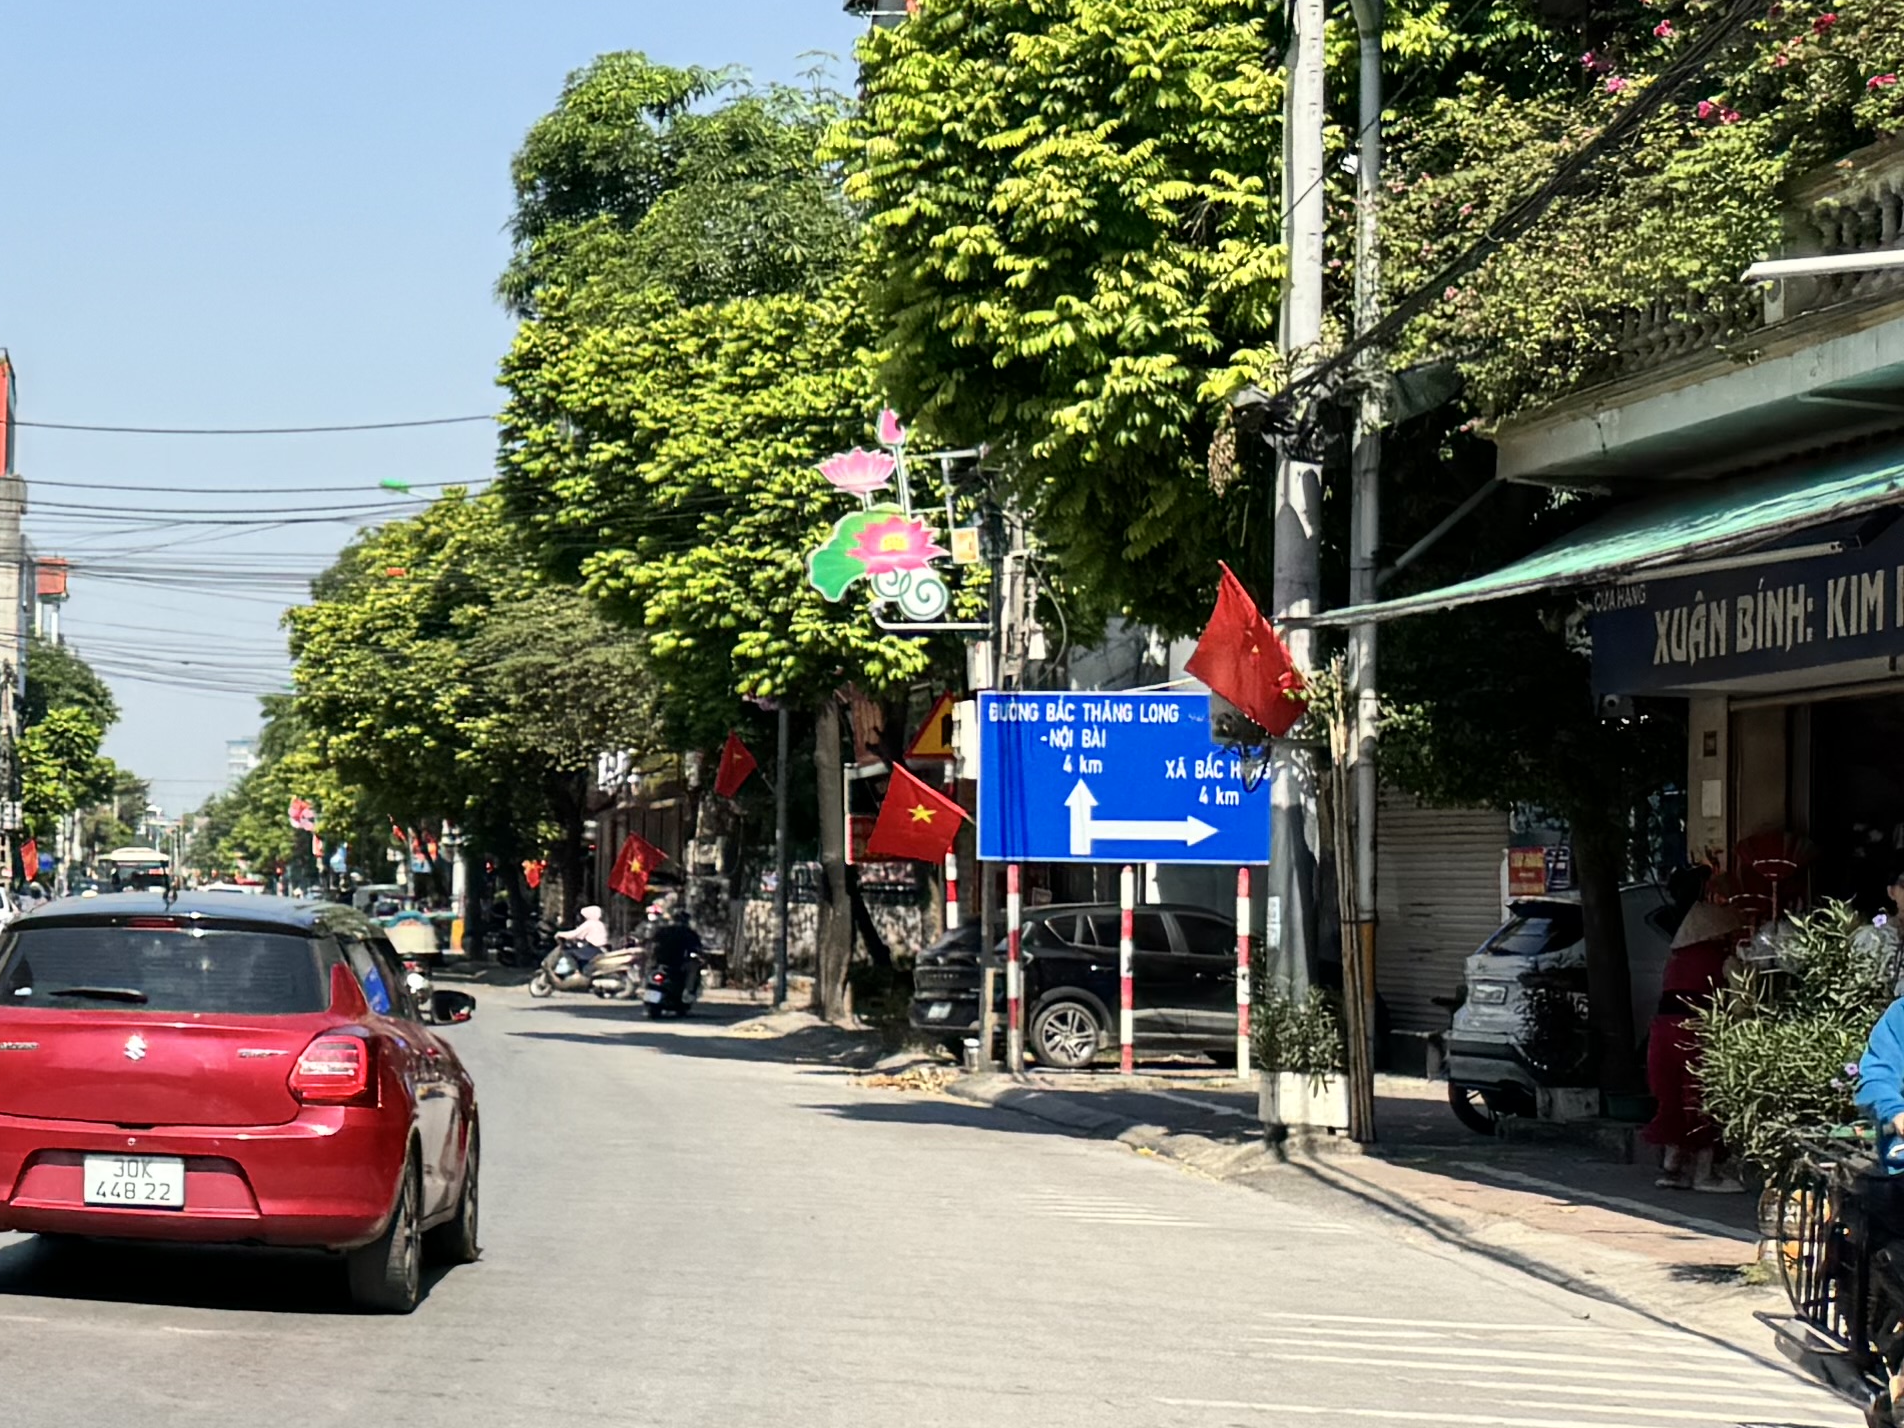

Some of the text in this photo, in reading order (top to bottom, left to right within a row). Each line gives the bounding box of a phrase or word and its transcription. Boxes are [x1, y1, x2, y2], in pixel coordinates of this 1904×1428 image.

[1653, 590, 1727, 667] XUÂN
[1827, 569, 1885, 640] KIM
[1045, 695, 1075, 722] BẮC
[1082, 700, 1133, 722] THĂNG
[1139, 704, 1180, 724] LONG
[1082, 725, 1106, 749] BÀI
[1063, 754, 1103, 774] 4 km
[1165, 755, 1187, 779] XÃ
[1195, 751, 1224, 779] BẮC
[1198, 785, 1240, 805] 4 km
[112, 1159, 153, 1179] 30K
